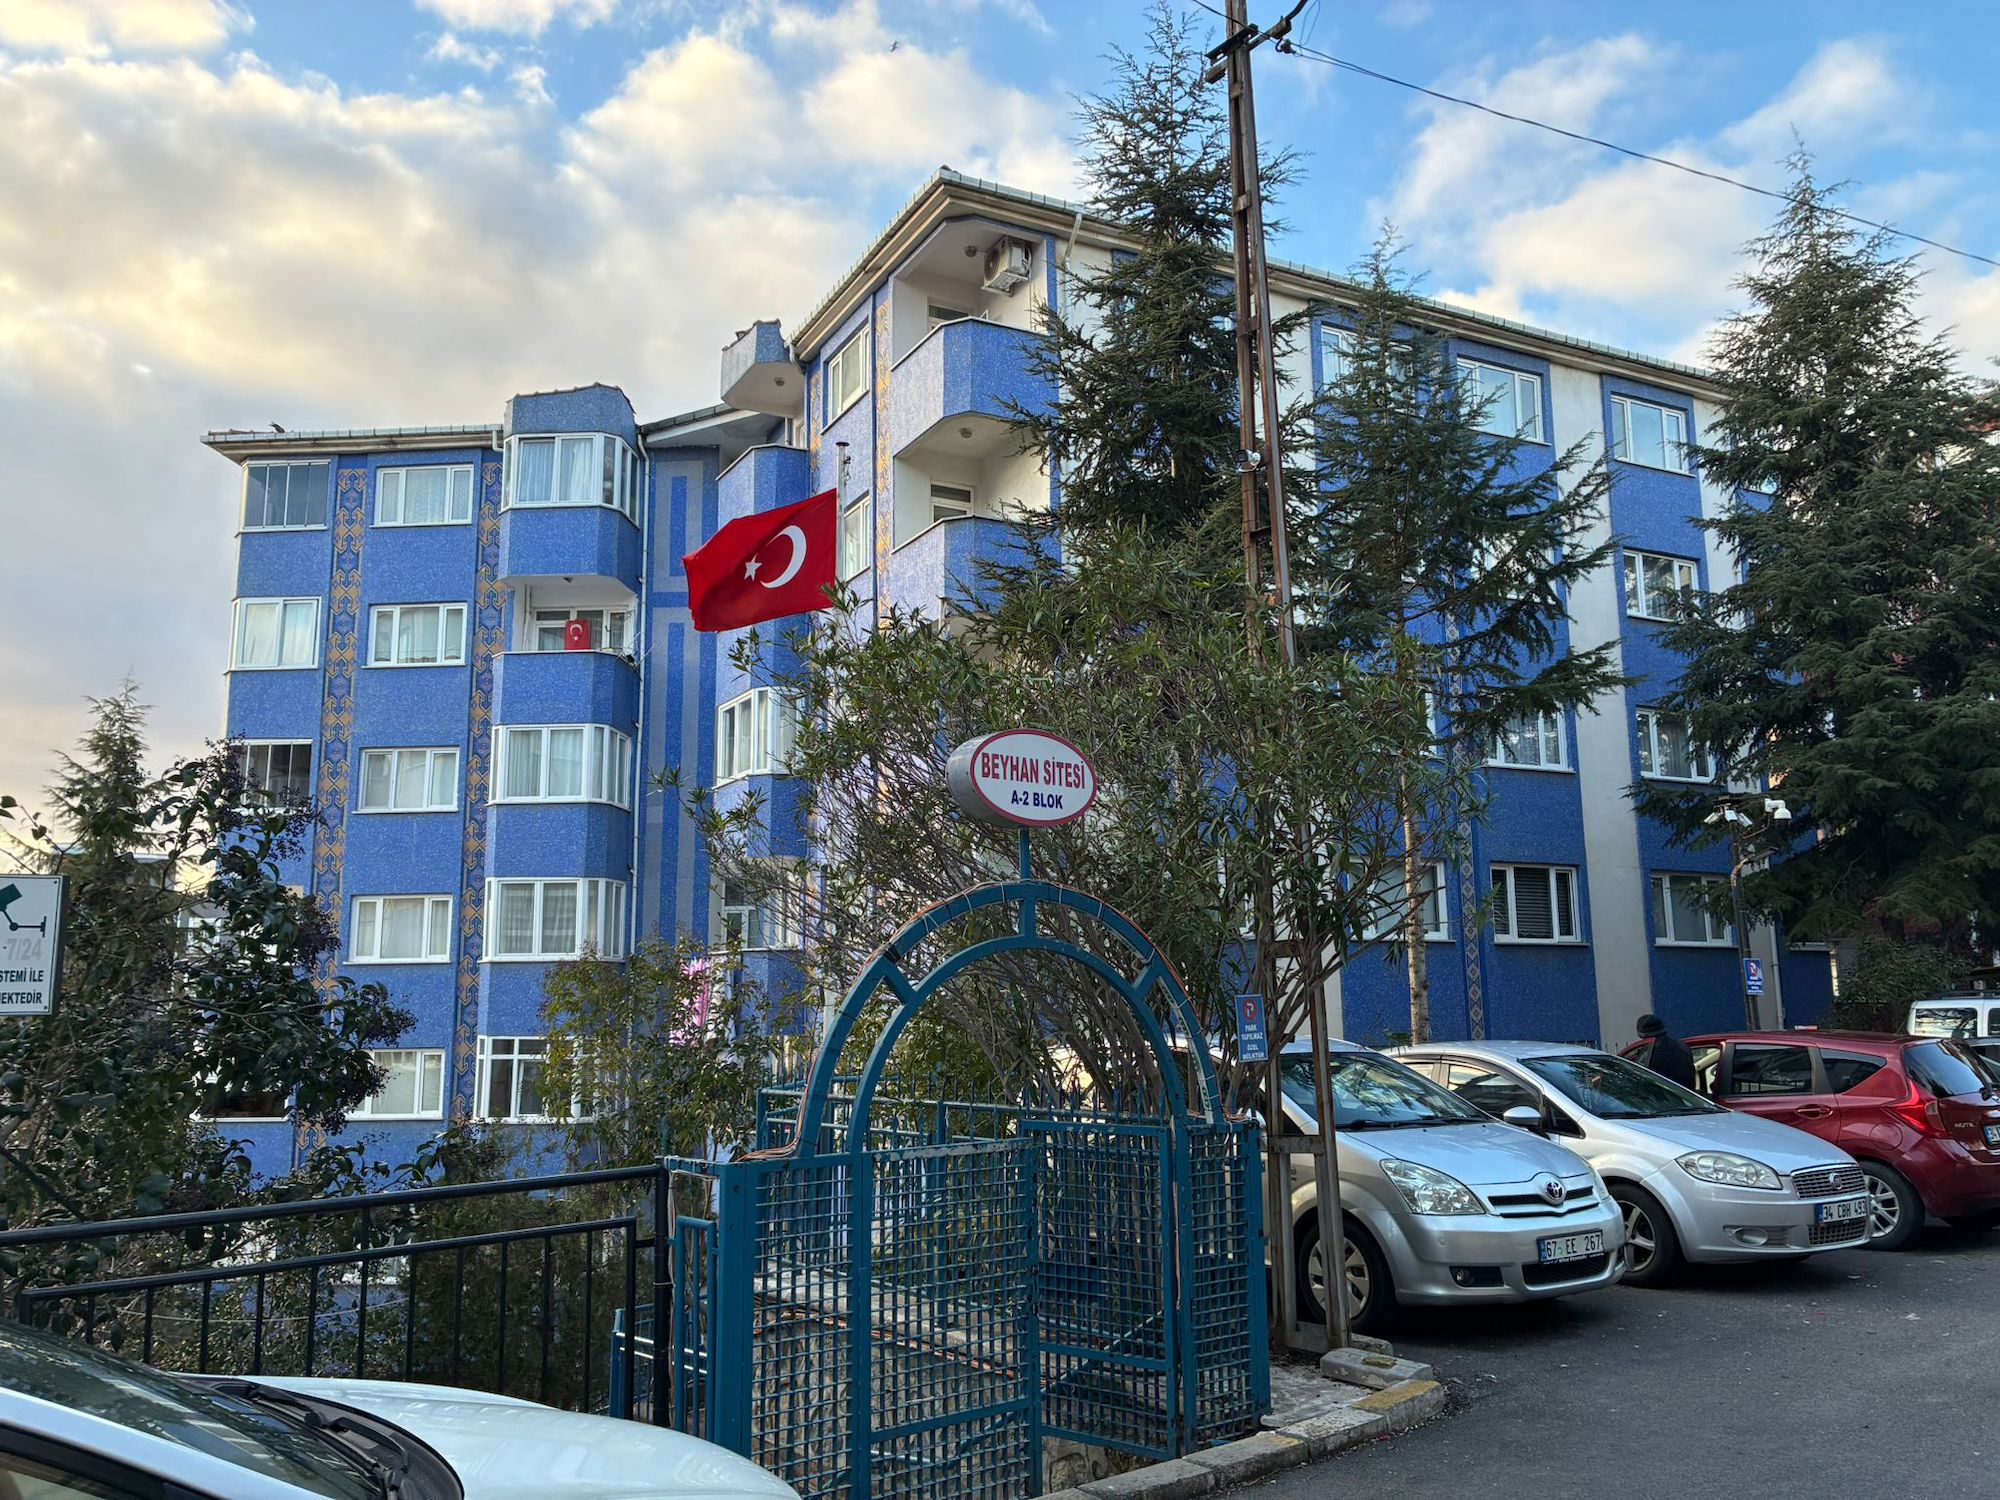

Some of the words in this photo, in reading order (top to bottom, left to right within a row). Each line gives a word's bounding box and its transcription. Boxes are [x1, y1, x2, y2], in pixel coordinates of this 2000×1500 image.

[981, 752, 1039, 783] BEYHAN
[1043, 757, 1085, 789] SİTESİ
[1011, 790, 1029, 806] A-2
[1033, 792, 1063, 810] BLOK
[29, 967, 44, 982] İLE
[0, 989, 42, 1004] EKTEDİR
[1823, 1205, 1833, 1220] 34
[1546, 1241, 1557, 1257] 67
[1566, 1238, 1577, 1254] EE
[1584, 1234, 1601, 1251] 267
